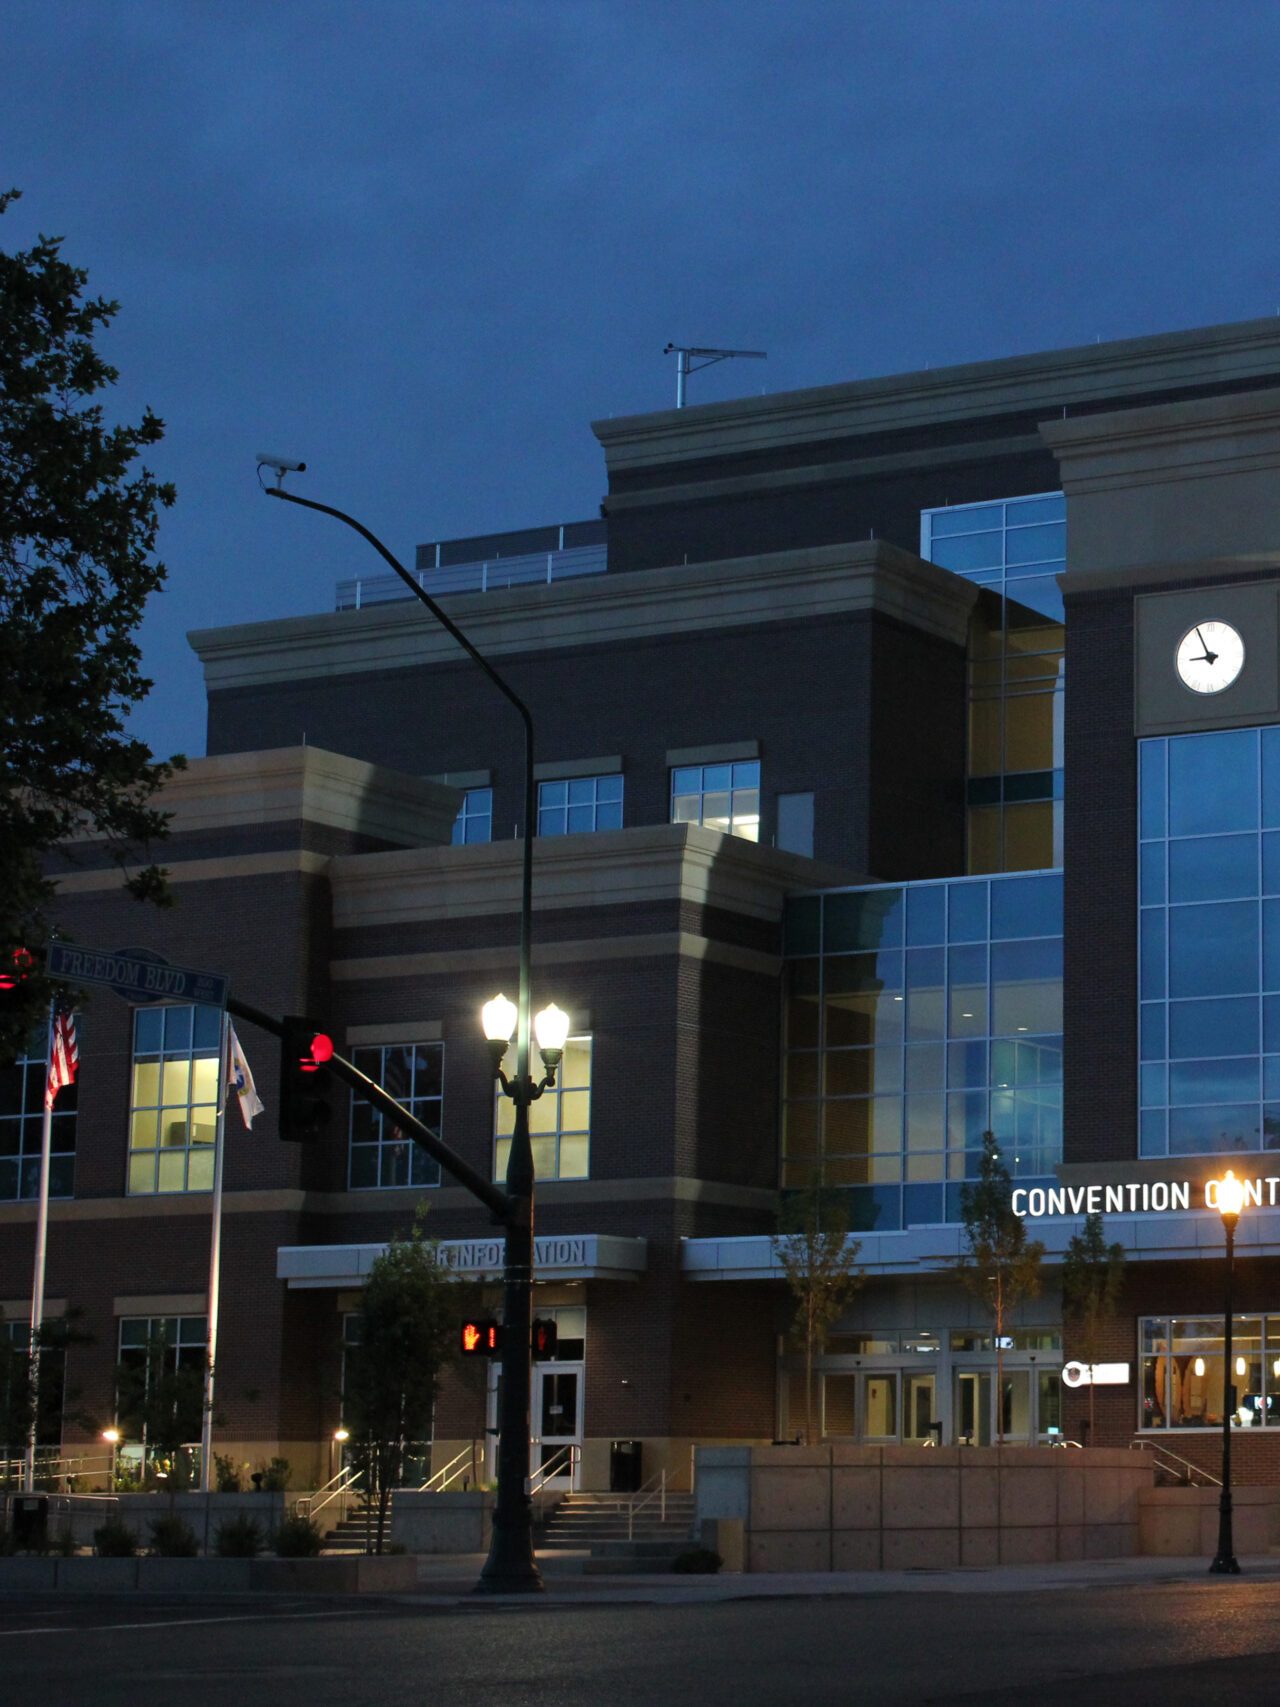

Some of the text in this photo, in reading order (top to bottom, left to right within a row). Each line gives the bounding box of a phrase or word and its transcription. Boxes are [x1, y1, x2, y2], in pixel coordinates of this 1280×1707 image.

[60, 949, 140, 987] FREEDOM
[144, 966, 187, 994] BLVD
[1011, 1181, 1190, 1217] CONVENTION
[454, 1241, 587, 1268] INFOATION
